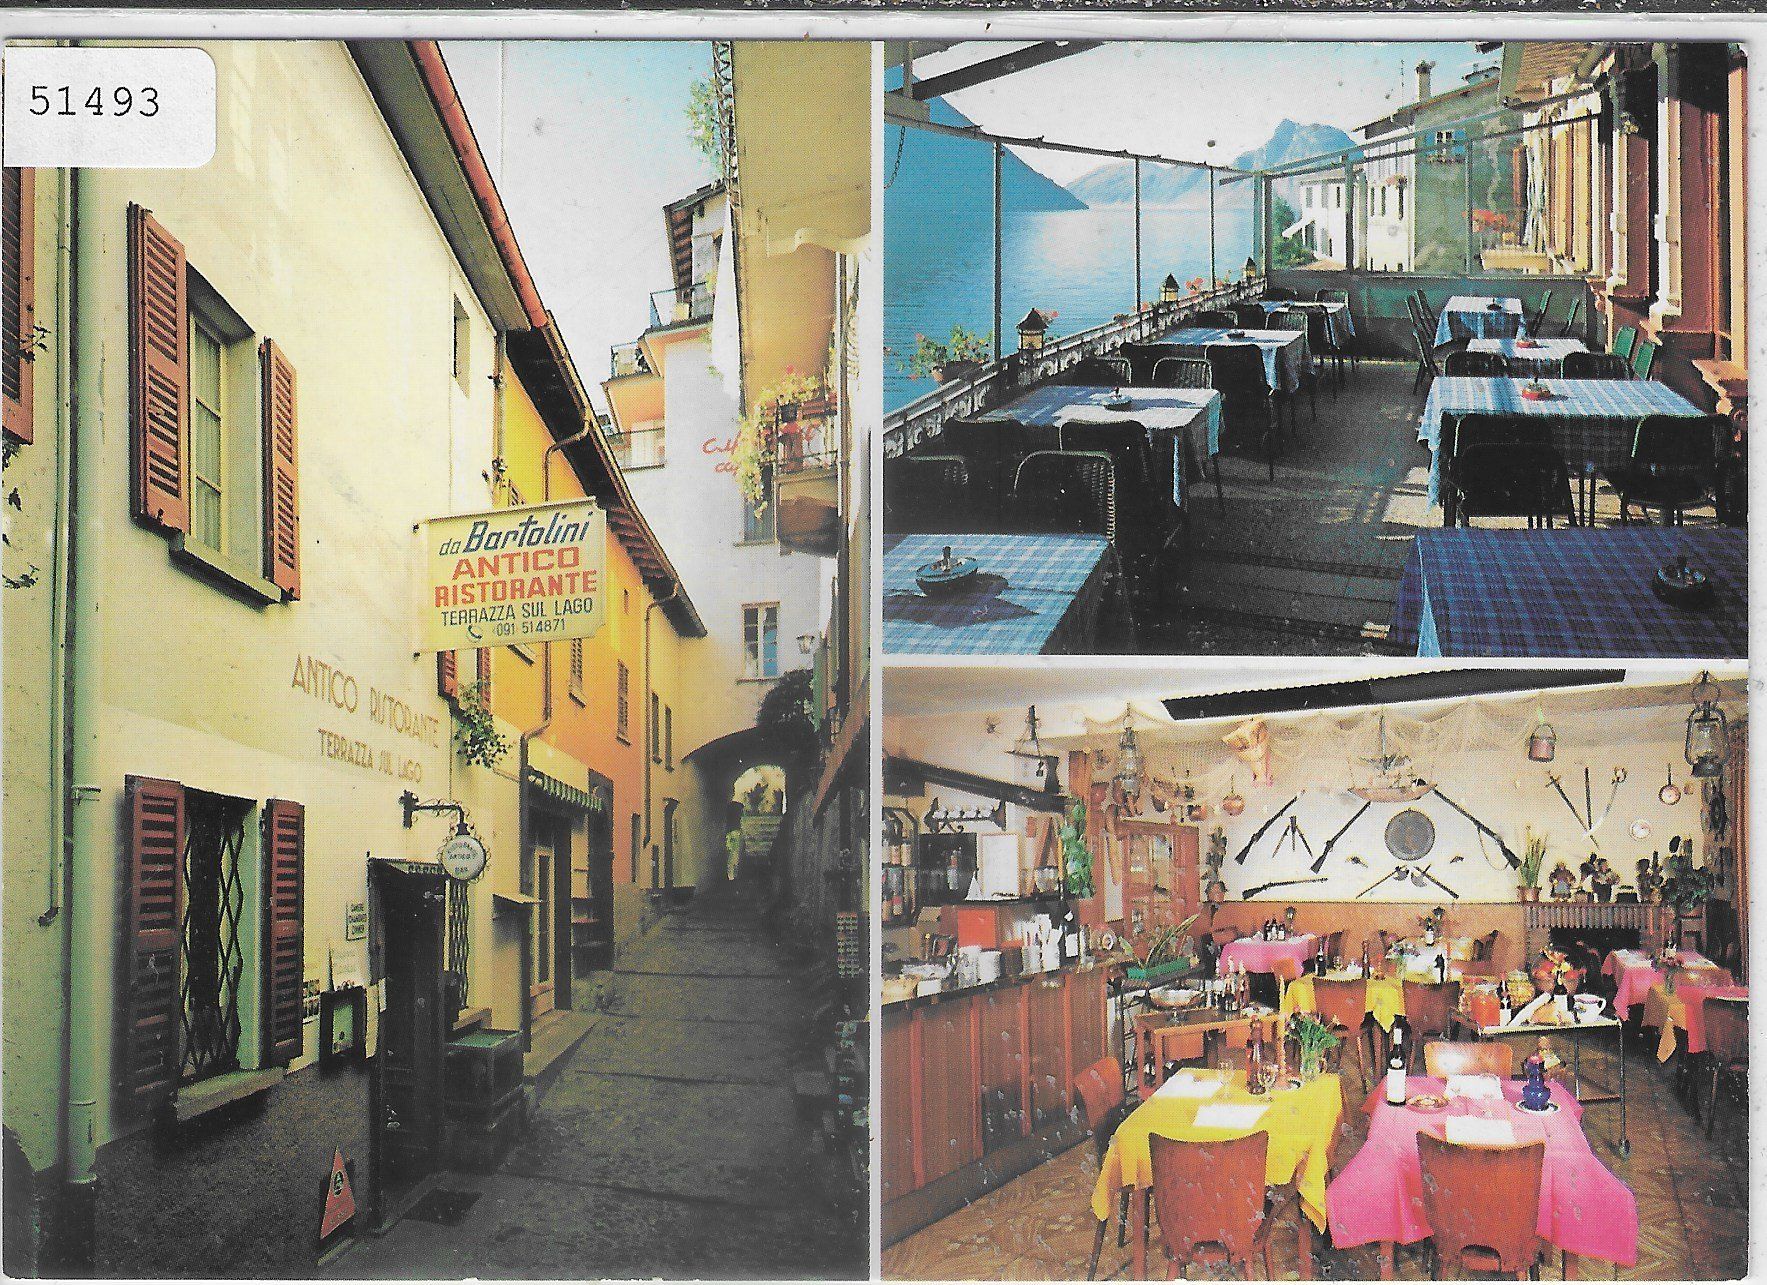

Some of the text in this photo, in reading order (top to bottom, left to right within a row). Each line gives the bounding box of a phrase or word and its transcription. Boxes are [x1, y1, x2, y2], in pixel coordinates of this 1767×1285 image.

[29, 85, 159, 117] 51493
[439, 511, 594, 556] da Bartolini
[452, 546, 580, 580] ANTICO
[434, 569, 597, 608] RISTORANTE
[441, 597, 593, 626] TERRAZZA SUL LAGO
[522, 618, 566, 634] 514871
[292, 653, 439, 748] ANTICO RISTORANTE
[318, 727, 374, 769] TERRAZZA
